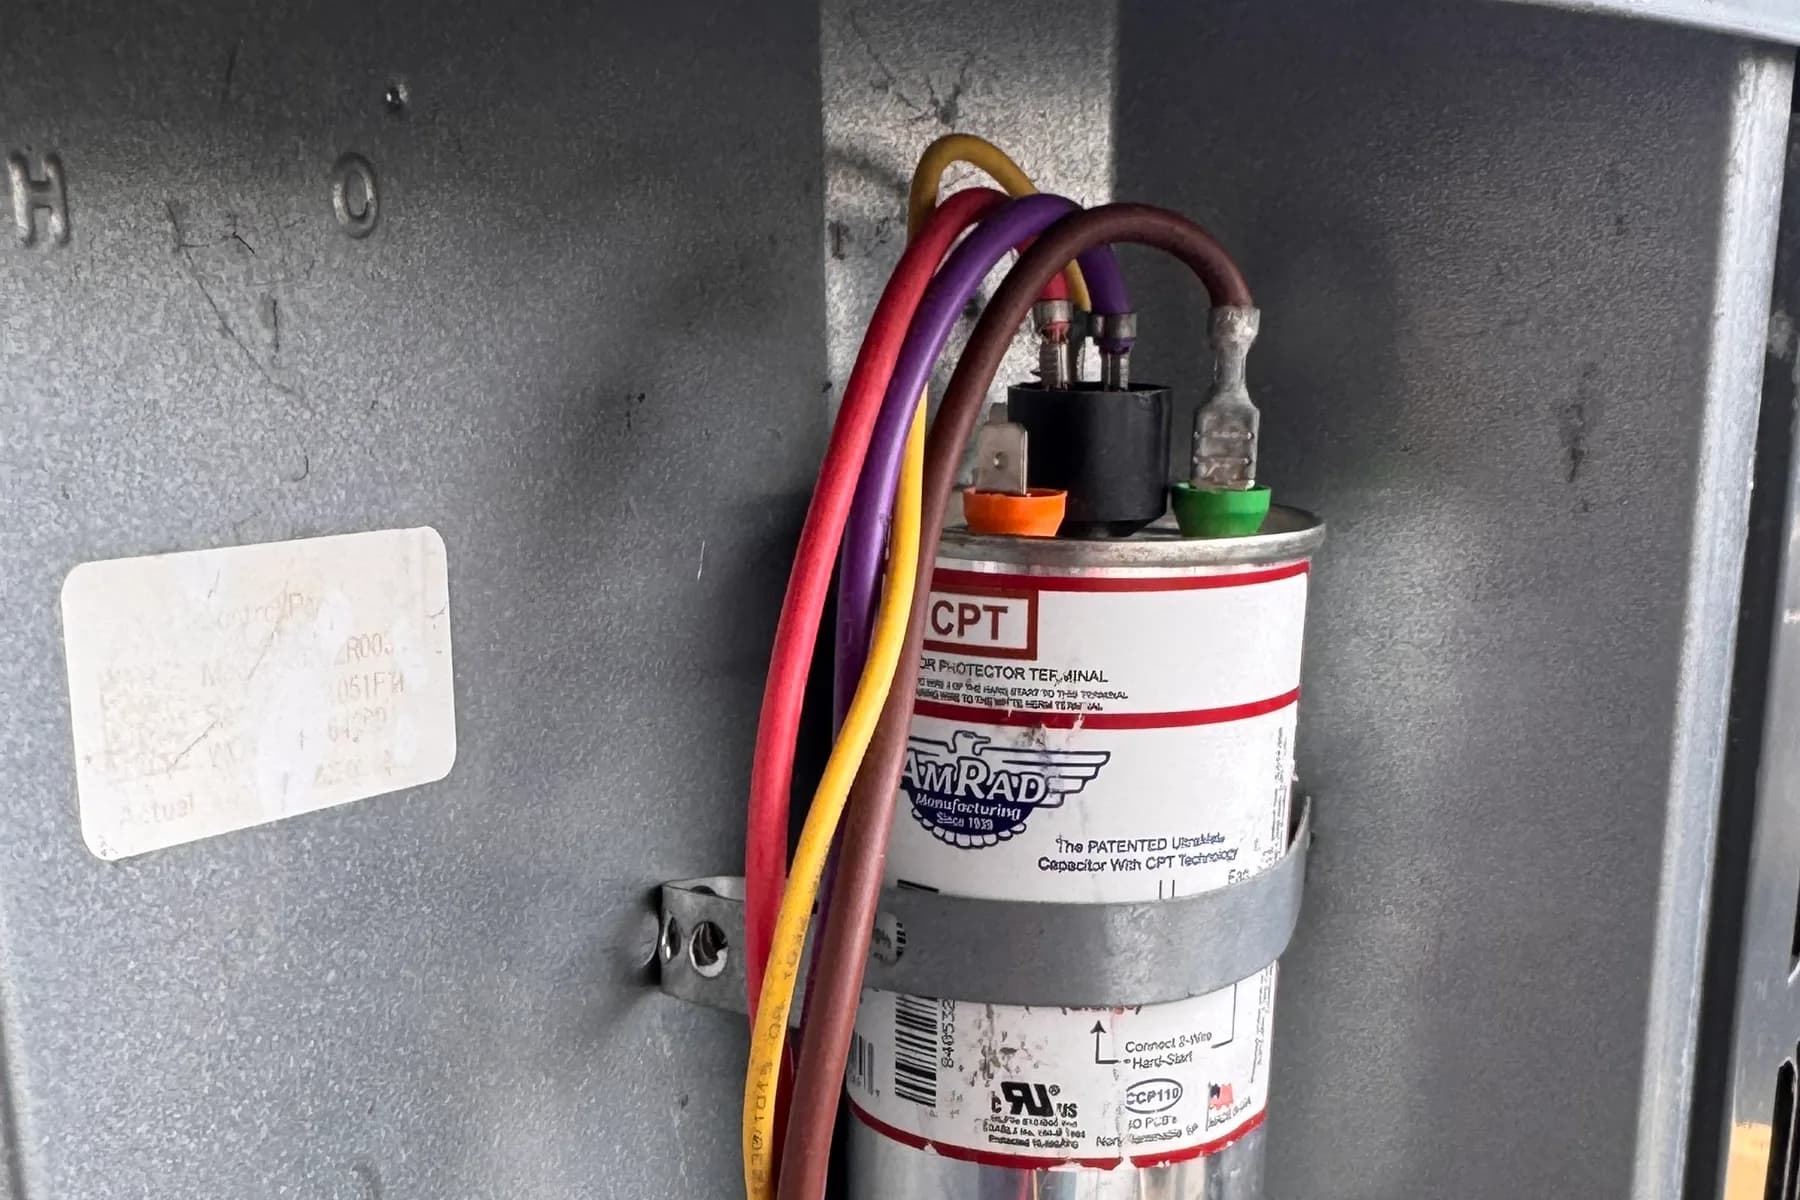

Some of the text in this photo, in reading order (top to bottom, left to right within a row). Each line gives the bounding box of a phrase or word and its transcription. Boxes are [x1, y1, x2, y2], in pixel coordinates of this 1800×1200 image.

[931, 599, 1008, 641] CPT
[939, 659, 1026, 680] PROTECTOR
[1056, 834, 1084, 854] The
[1087, 837, 1168, 854] PATENTED
[1037, 856, 1107, 873] Capacitor
[1145, 855, 1176, 870] CPT
